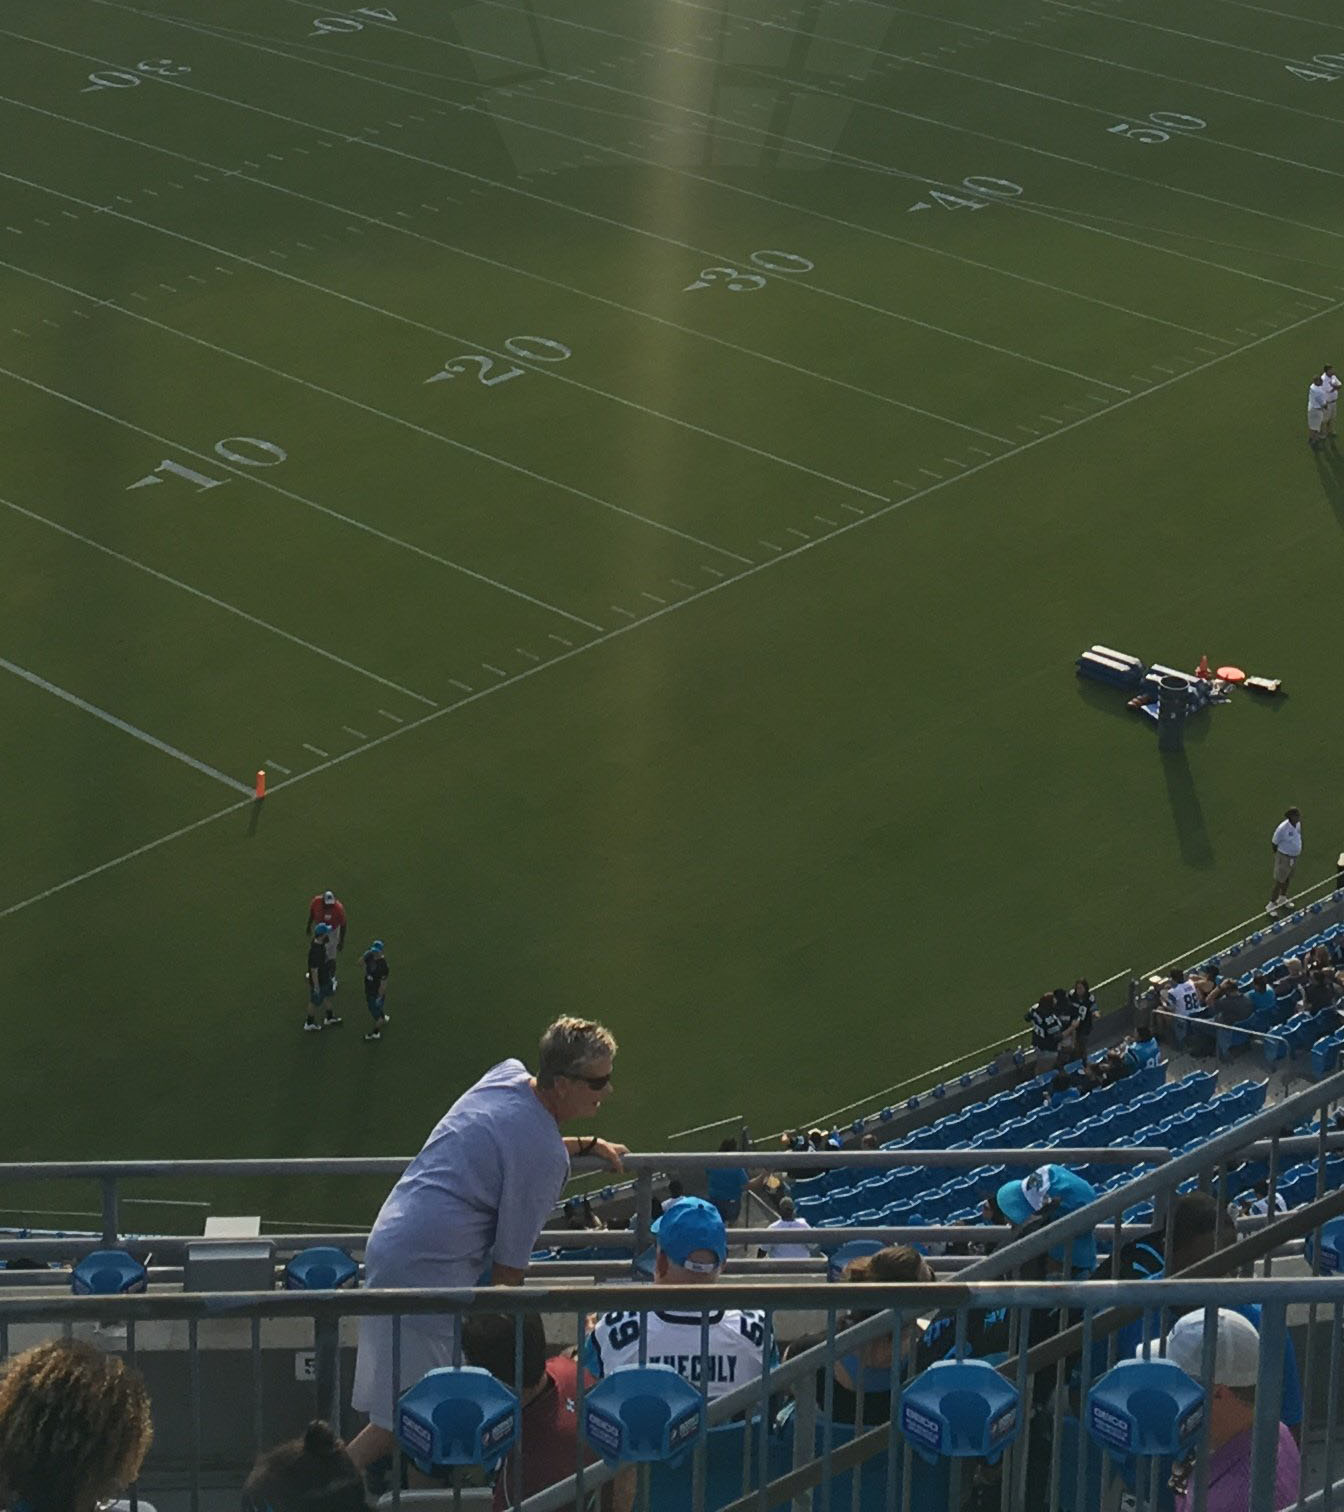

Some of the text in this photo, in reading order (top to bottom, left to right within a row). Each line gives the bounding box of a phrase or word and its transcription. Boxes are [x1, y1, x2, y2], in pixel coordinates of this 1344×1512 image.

[87, 58, 191, 91] 30
[1107, 111, 1207, 143] 50
[927, 174, 1024, 213] 40
[700, 249, 814, 292] 30
[445, 334, 573, 387] 20
[157, 435, 287, 492] 10
